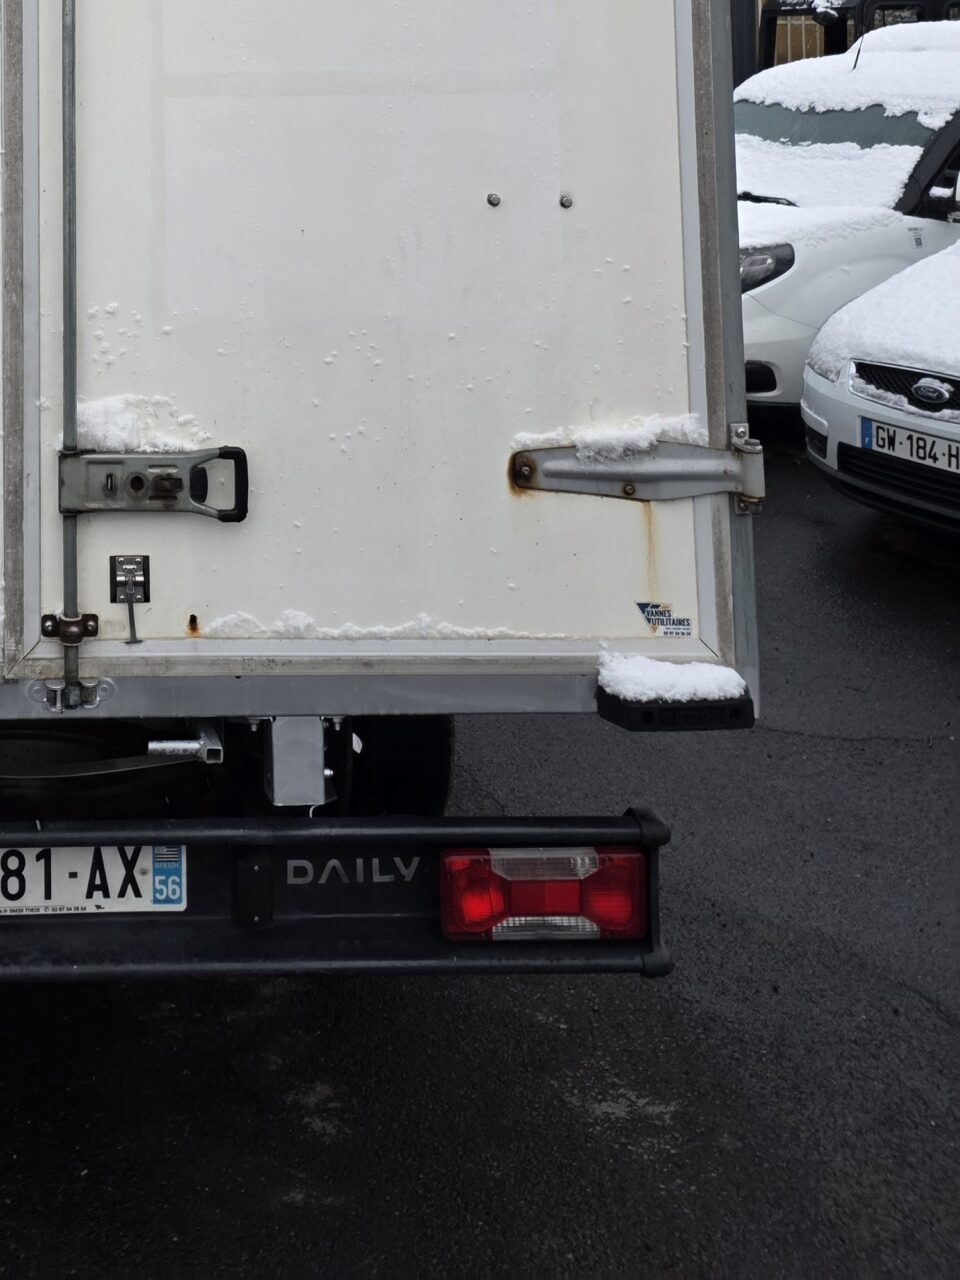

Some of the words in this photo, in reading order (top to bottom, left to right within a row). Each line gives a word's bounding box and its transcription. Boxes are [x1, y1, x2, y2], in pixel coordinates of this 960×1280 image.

[646, 609, 672, 618] VANNES
[651, 618, 690, 627] UTILITAIRES
[286, 857, 421, 885] DAILY
[154, 875, 181, 900] 56
